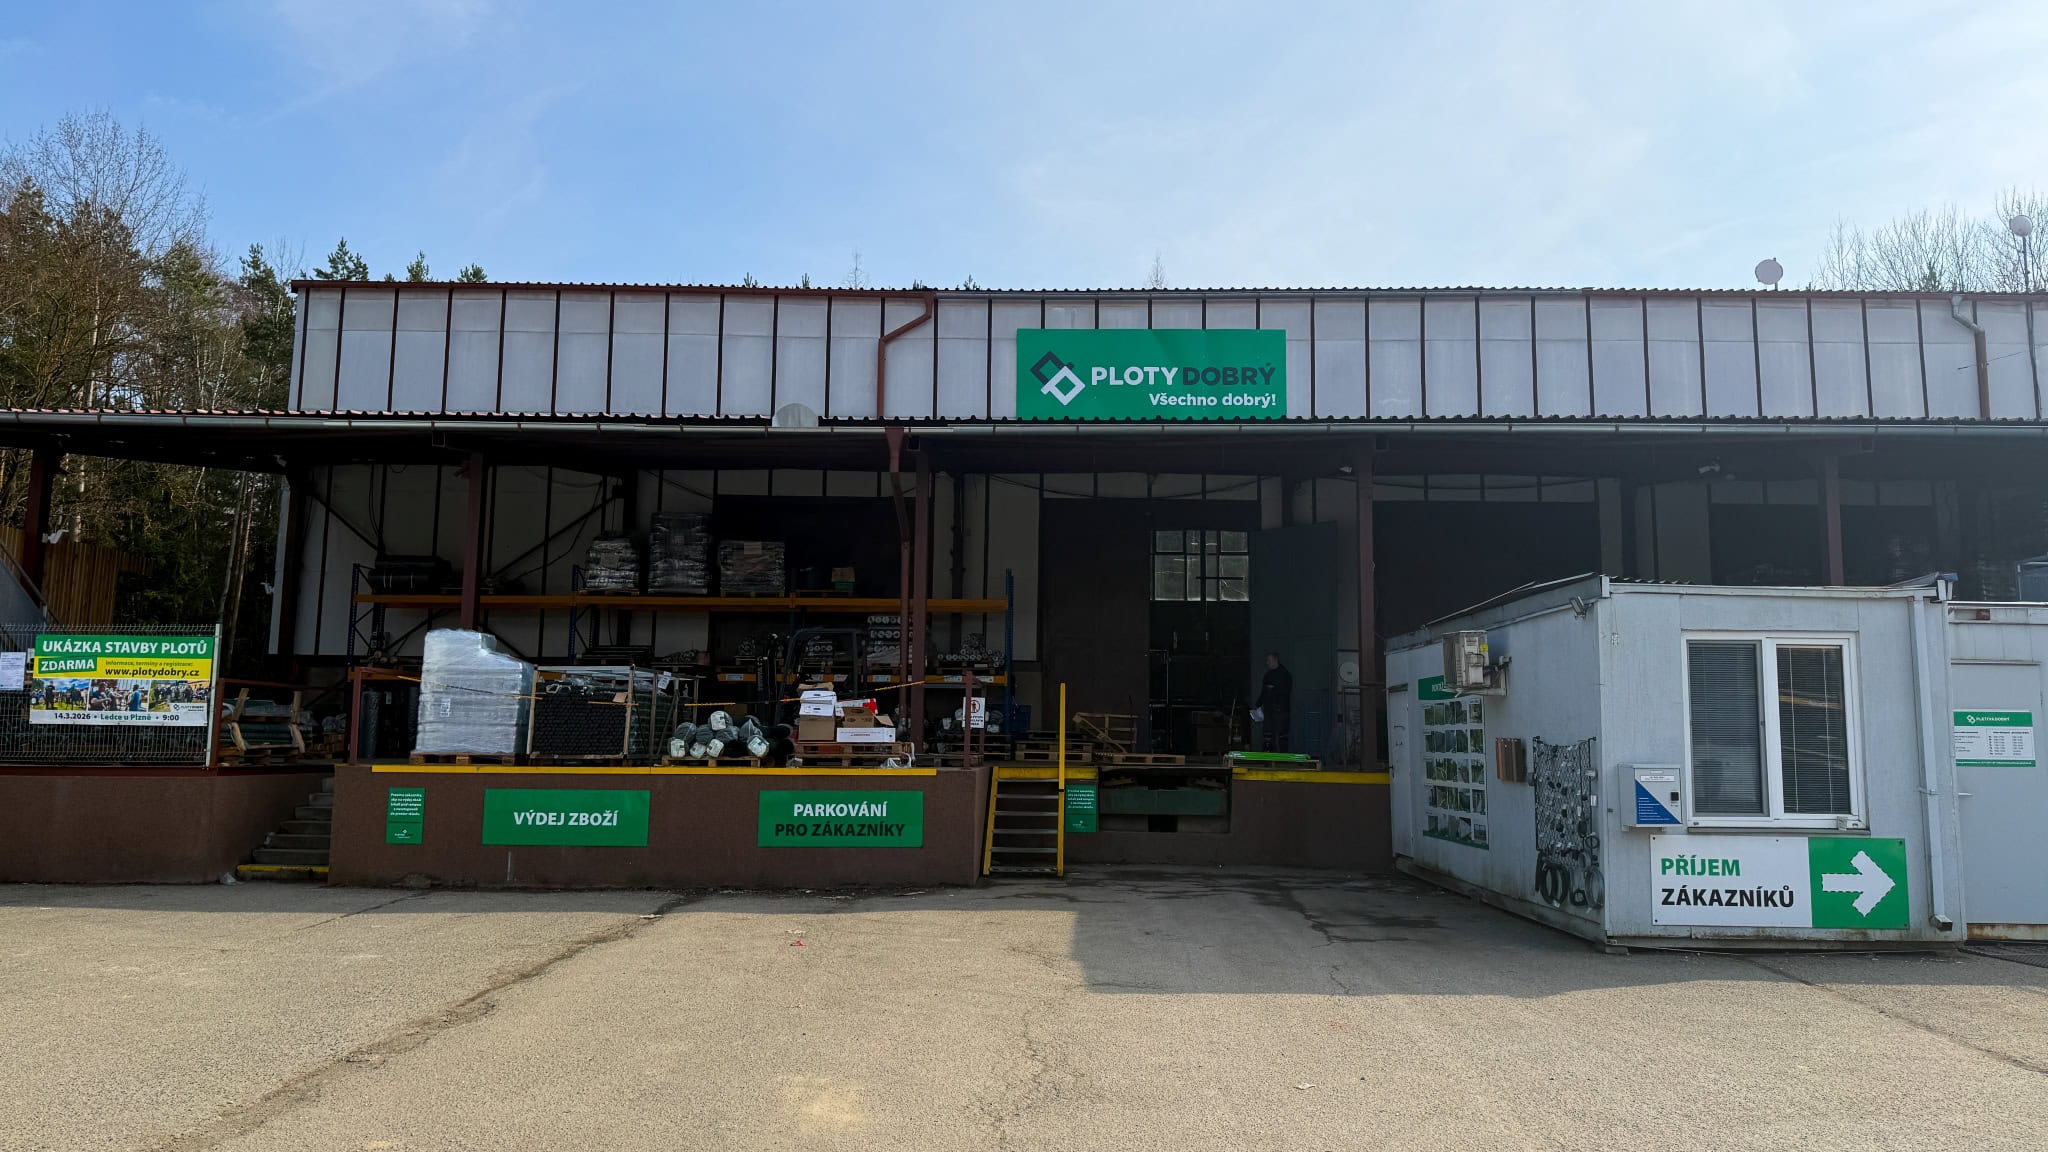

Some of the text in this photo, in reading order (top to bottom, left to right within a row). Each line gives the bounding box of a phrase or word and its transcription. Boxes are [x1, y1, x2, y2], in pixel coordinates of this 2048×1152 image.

[1091, 362, 1276, 386] PLOTY DOBRÝ
[1149, 392, 1277, 408] Všechno dobrý!
[42, 638, 207, 655] UKÁZKA STAVBY PLOTŮ
[41, 658, 95, 671] ZDARMA
[105, 668, 200, 678] www.plotydobry.cz
[54, 712, 91, 720] 14.3.2026
[100, 713, 122, 721] Ledce
[513, 809, 619, 826] VÝDEJ ZBOŽÍ
[793, 801, 887, 817] PARKOVÁNÍ
[775, 821, 905, 838] PRO ZÁKAZNÍKY
[1660, 854, 1741, 877] PŘÍJEM
[1661, 885, 1794, 908] ZÁKAZNÍKŮ
